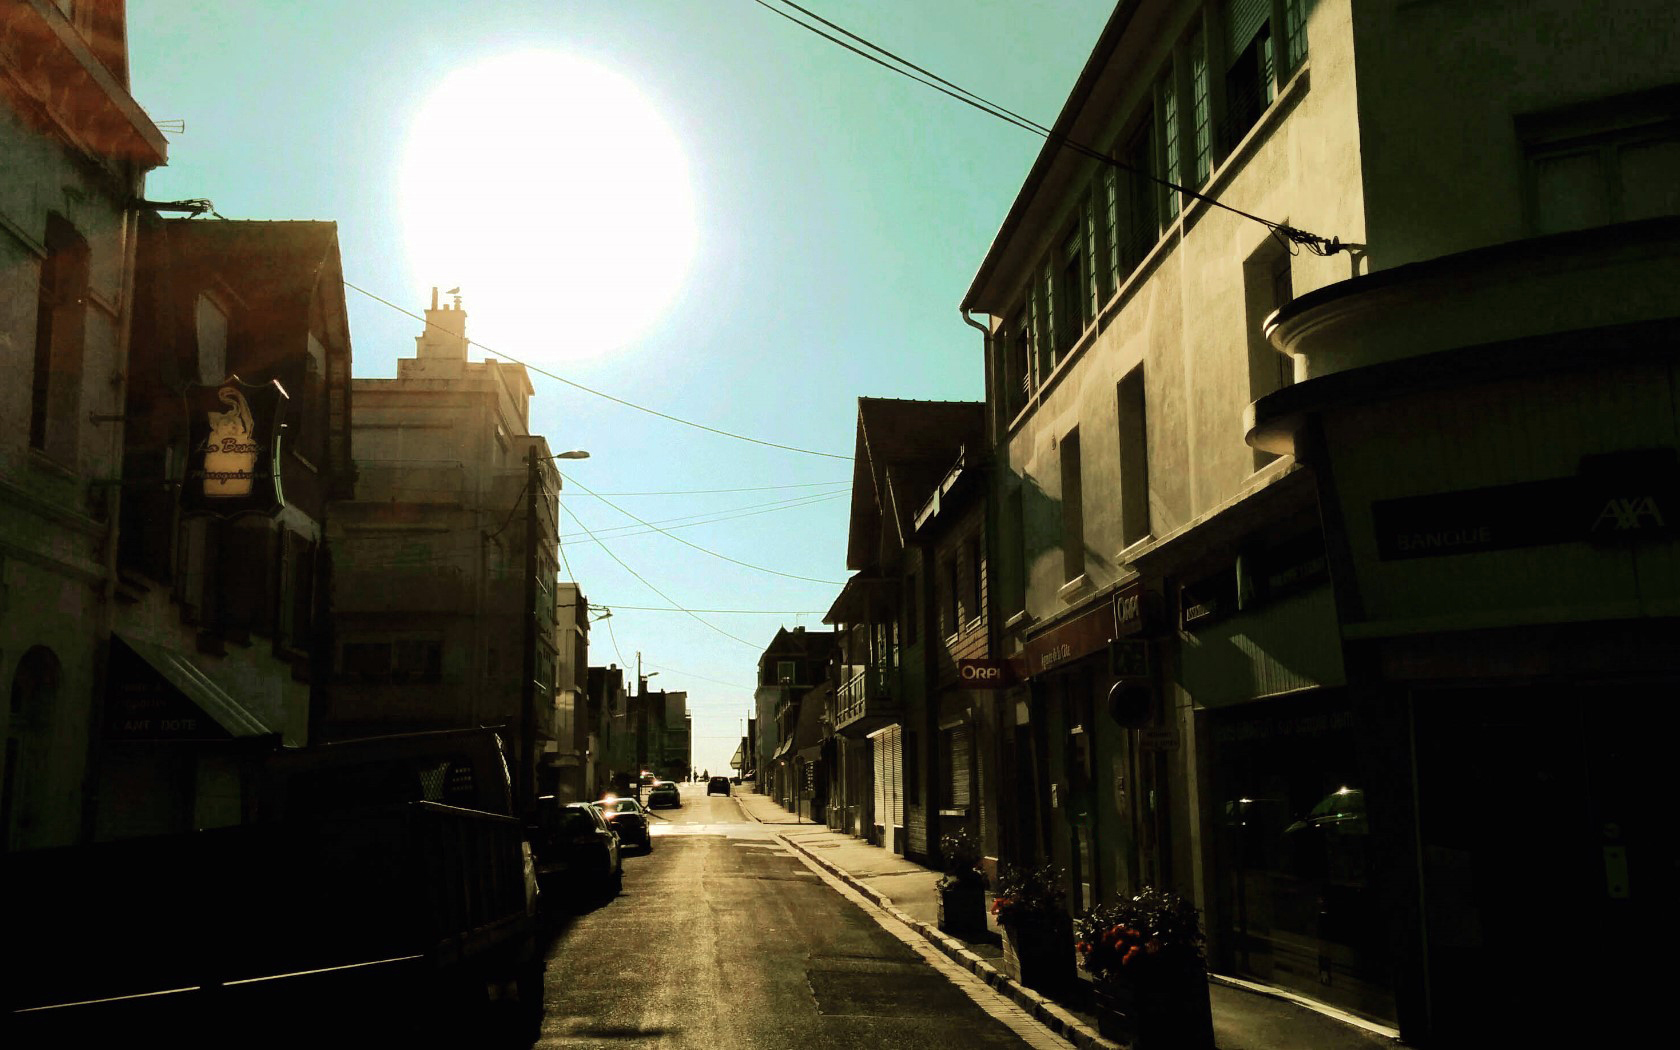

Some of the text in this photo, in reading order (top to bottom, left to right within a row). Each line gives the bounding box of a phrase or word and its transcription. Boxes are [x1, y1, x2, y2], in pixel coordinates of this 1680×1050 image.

[195, 438, 220, 454] La
[1590, 496, 1666, 532] AXA
[1397, 526, 1492, 551] BANQUE
[1117, 594, 1139, 623] ORPI
[961, 664, 1001, 680] ORPI
